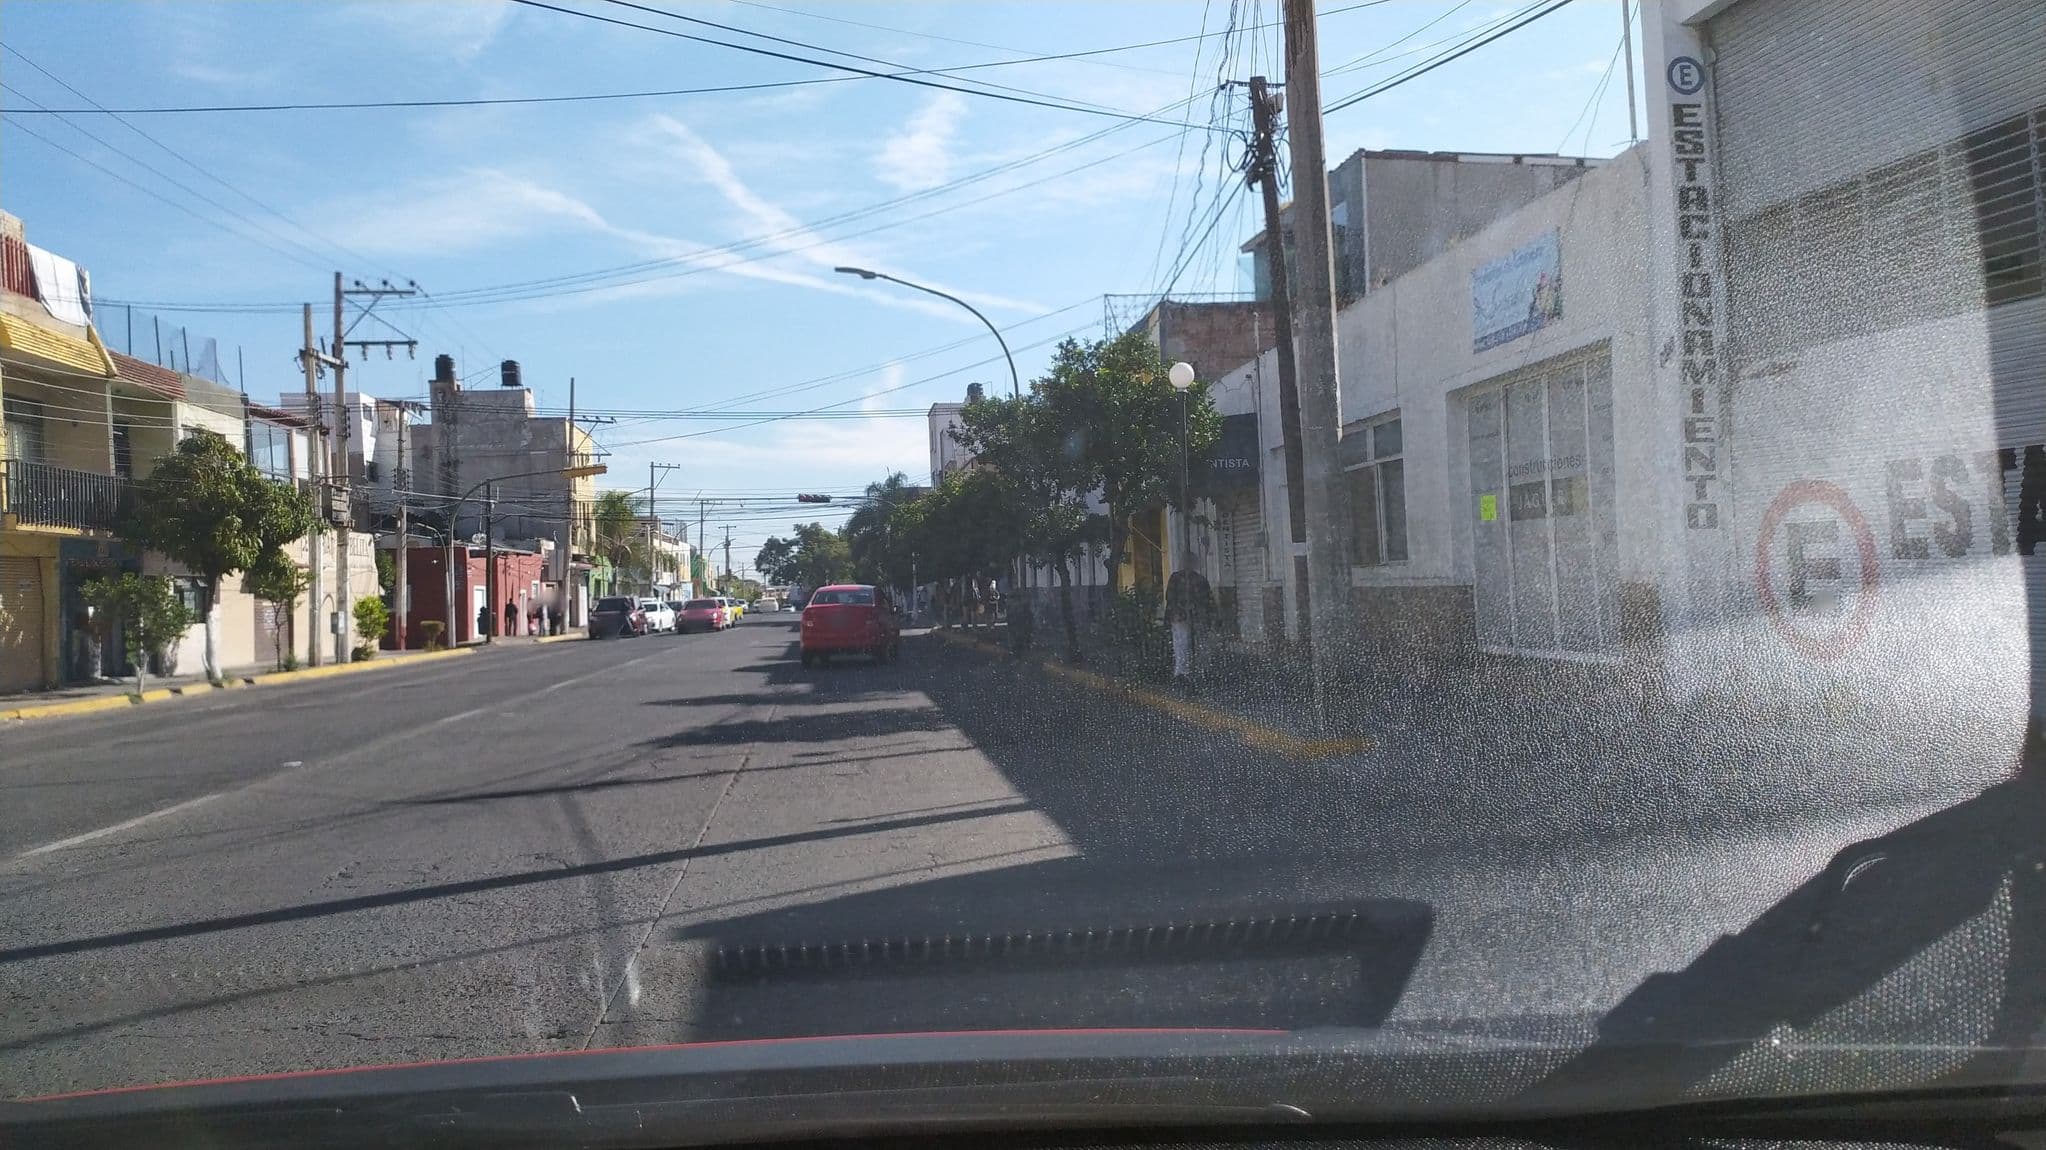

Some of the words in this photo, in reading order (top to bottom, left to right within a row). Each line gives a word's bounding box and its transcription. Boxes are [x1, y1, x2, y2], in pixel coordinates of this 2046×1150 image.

[1679, 64, 1693, 86] E
[1672, 103, 1719, 530] ESTACIONAMIENTO
[1206, 458, 1250, 469] NTISTA
